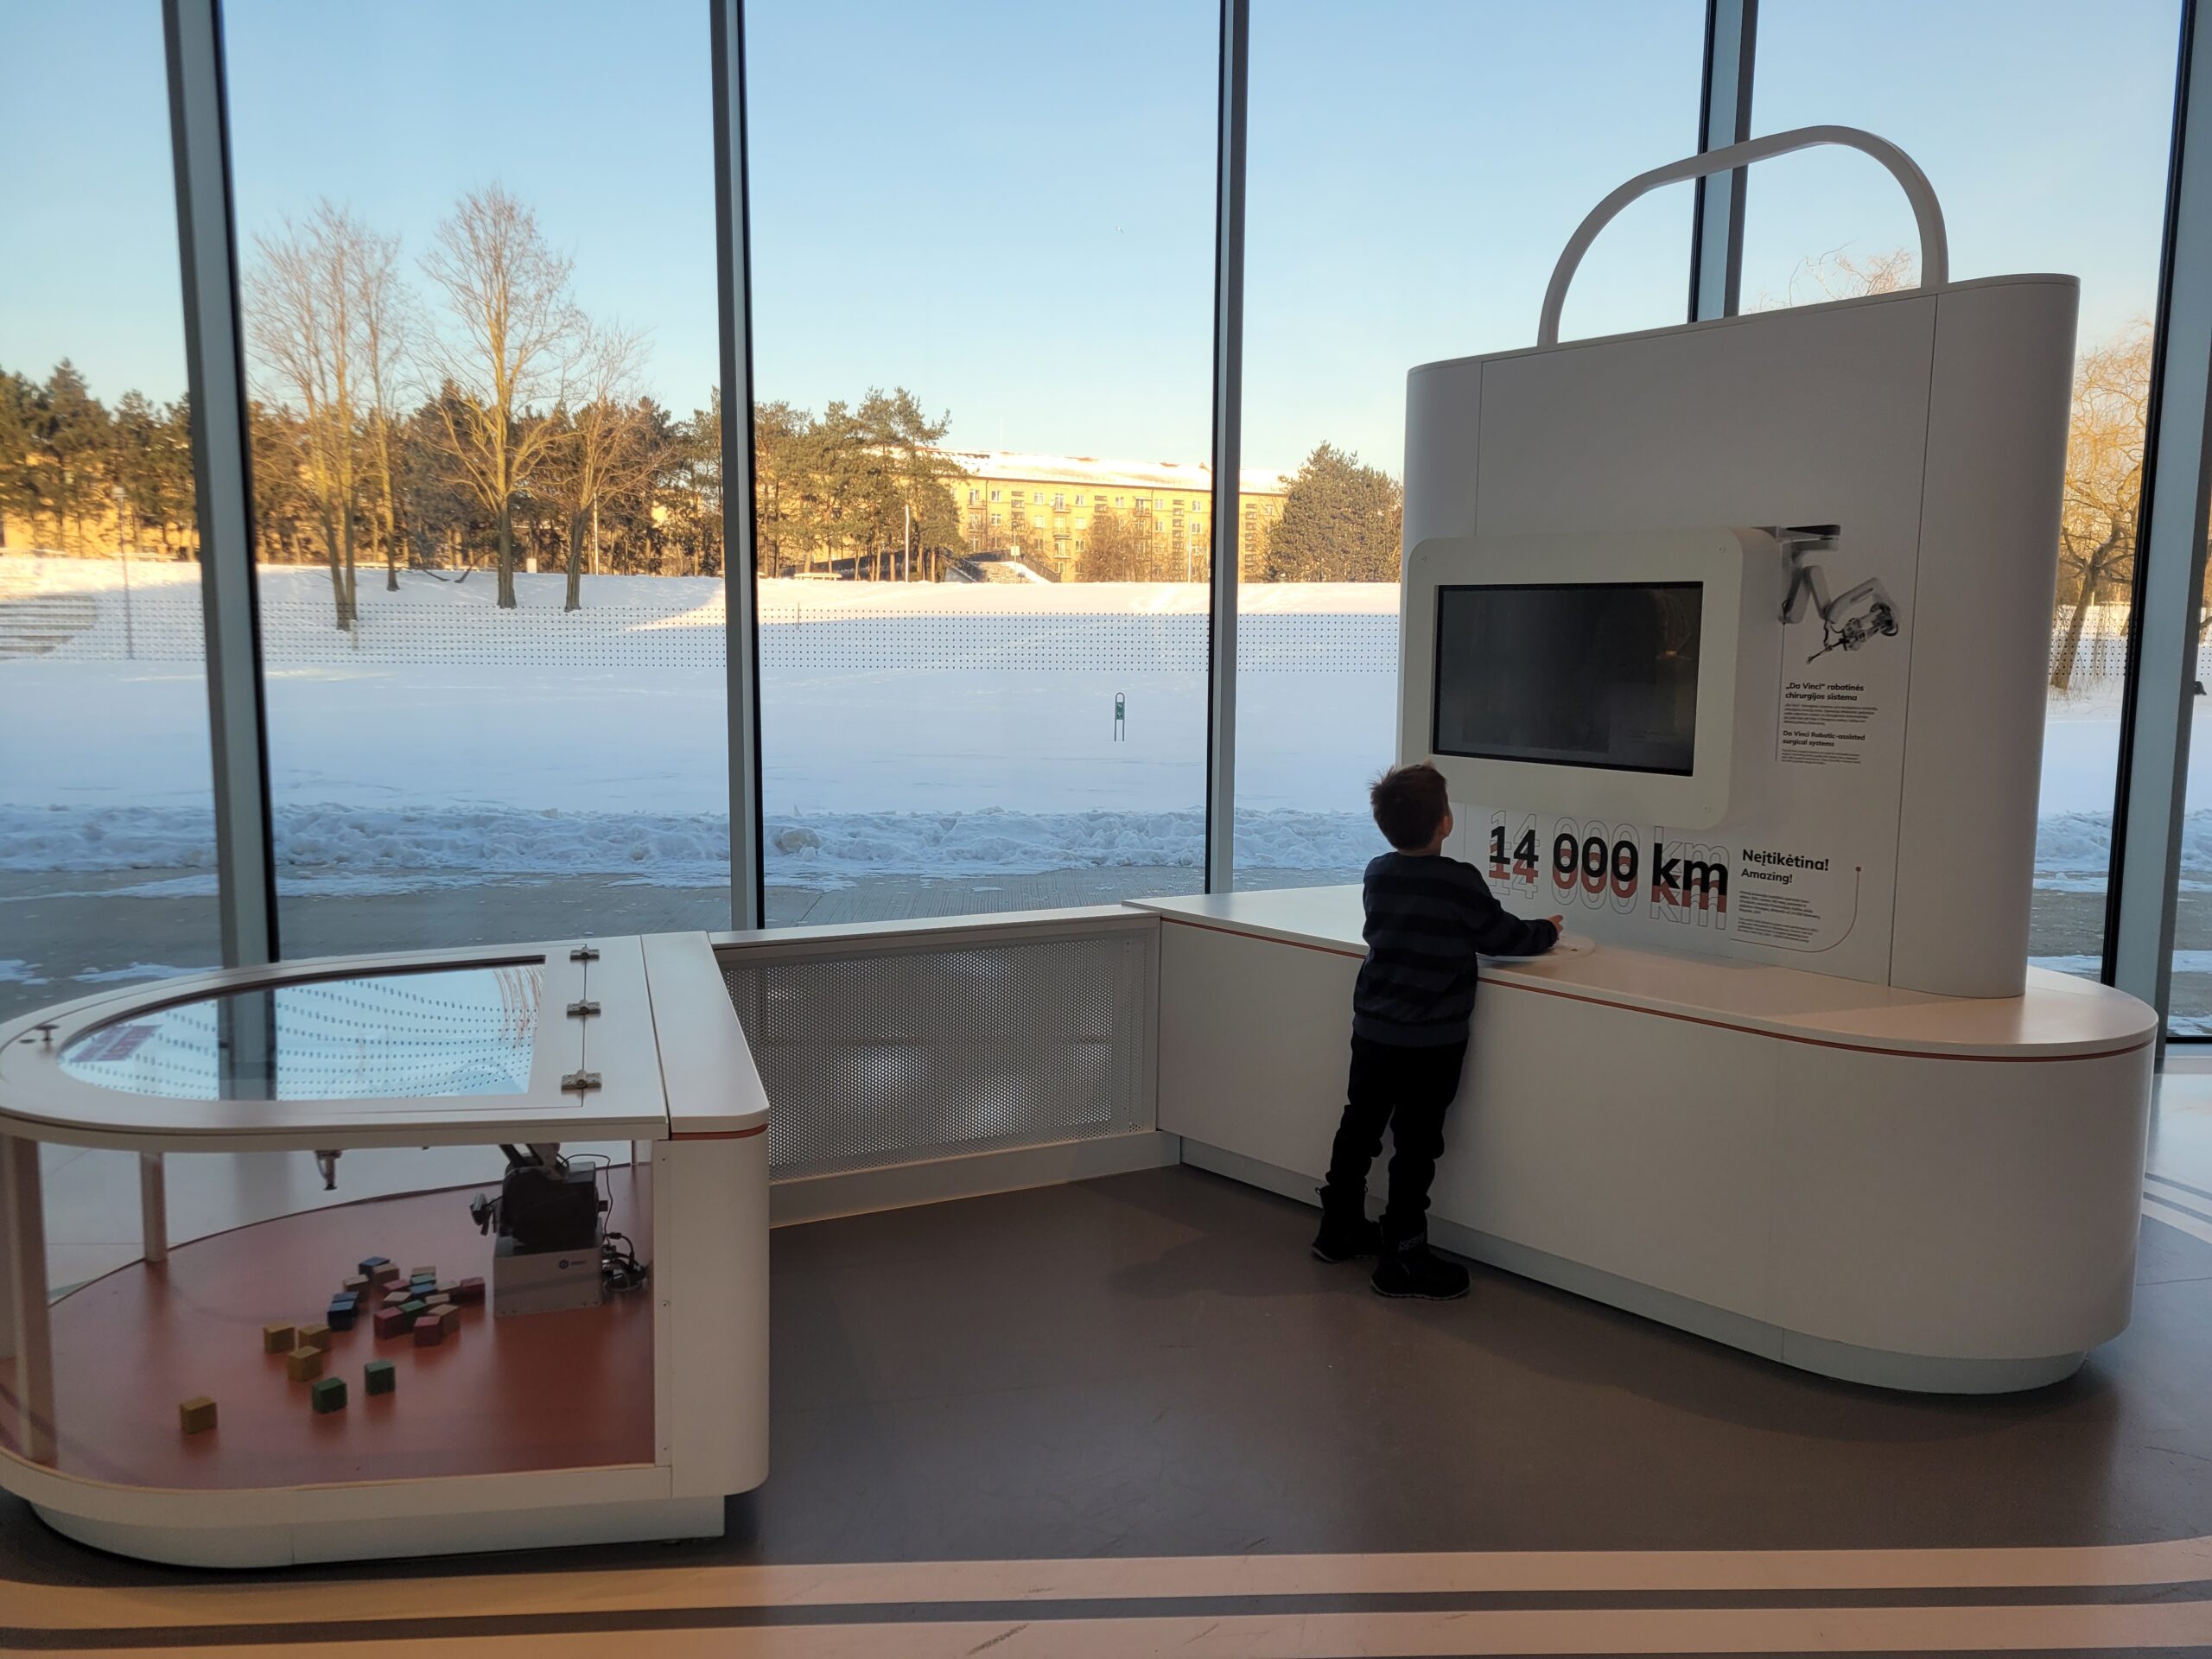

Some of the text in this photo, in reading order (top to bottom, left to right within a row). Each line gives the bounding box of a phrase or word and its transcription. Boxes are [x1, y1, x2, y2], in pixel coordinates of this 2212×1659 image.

[1785, 692, 1825, 702] chirurgijos
[1811, 732, 1866, 741] Robotic-assisted
[1489, 825, 1540, 883] 14
[1553, 833, 1638, 898] 000
[1651, 842, 1728, 912] km
[1742, 849, 1830, 871] Neįtikėtina!
[1741, 868, 1793, 885] Amazing!
